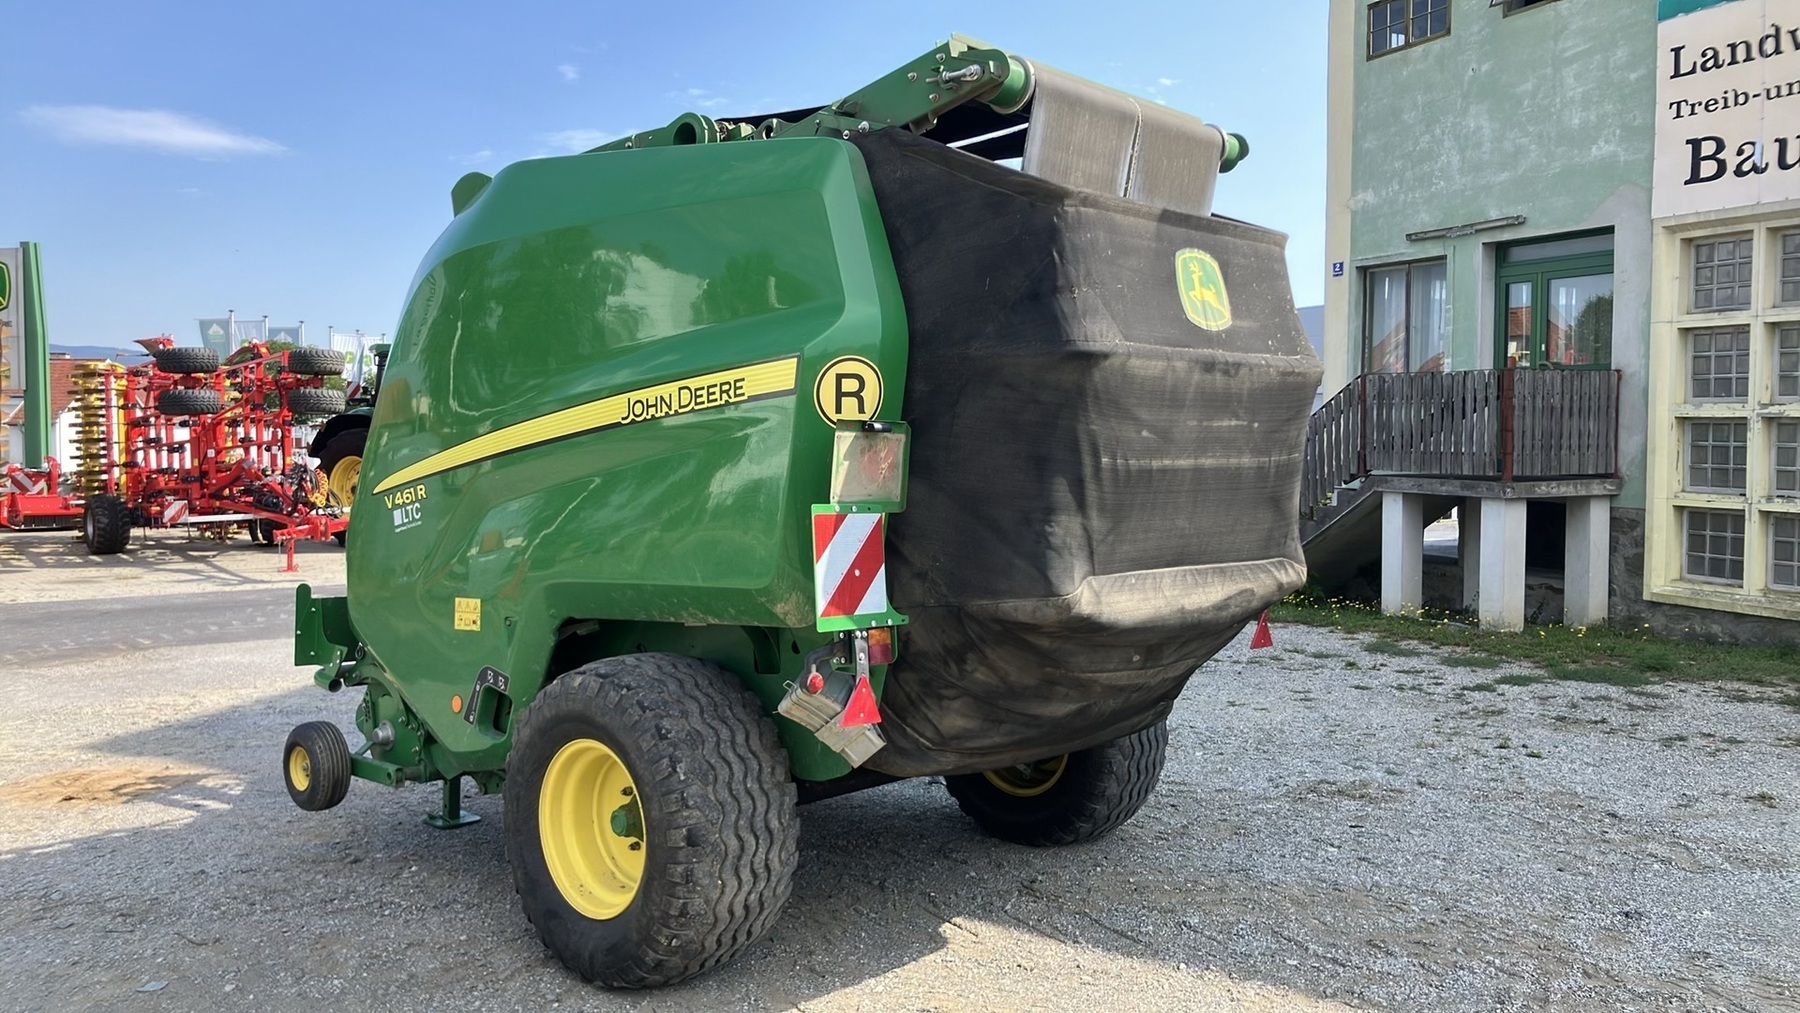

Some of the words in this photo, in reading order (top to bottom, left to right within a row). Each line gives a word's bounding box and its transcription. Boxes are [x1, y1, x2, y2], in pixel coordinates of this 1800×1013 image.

[1683, 134, 1800, 186] Bau
[1334, 262, 1342, 272] 2
[621, 393, 673, 421] JOHN
[678, 377, 746, 410] DEERE
[835, 372, 867, 415] R
[384, 494, 393, 509] V
[394, 487, 416, 506] 461
[416, 484, 427, 500] R
[402, 502, 422, 523] LTC
